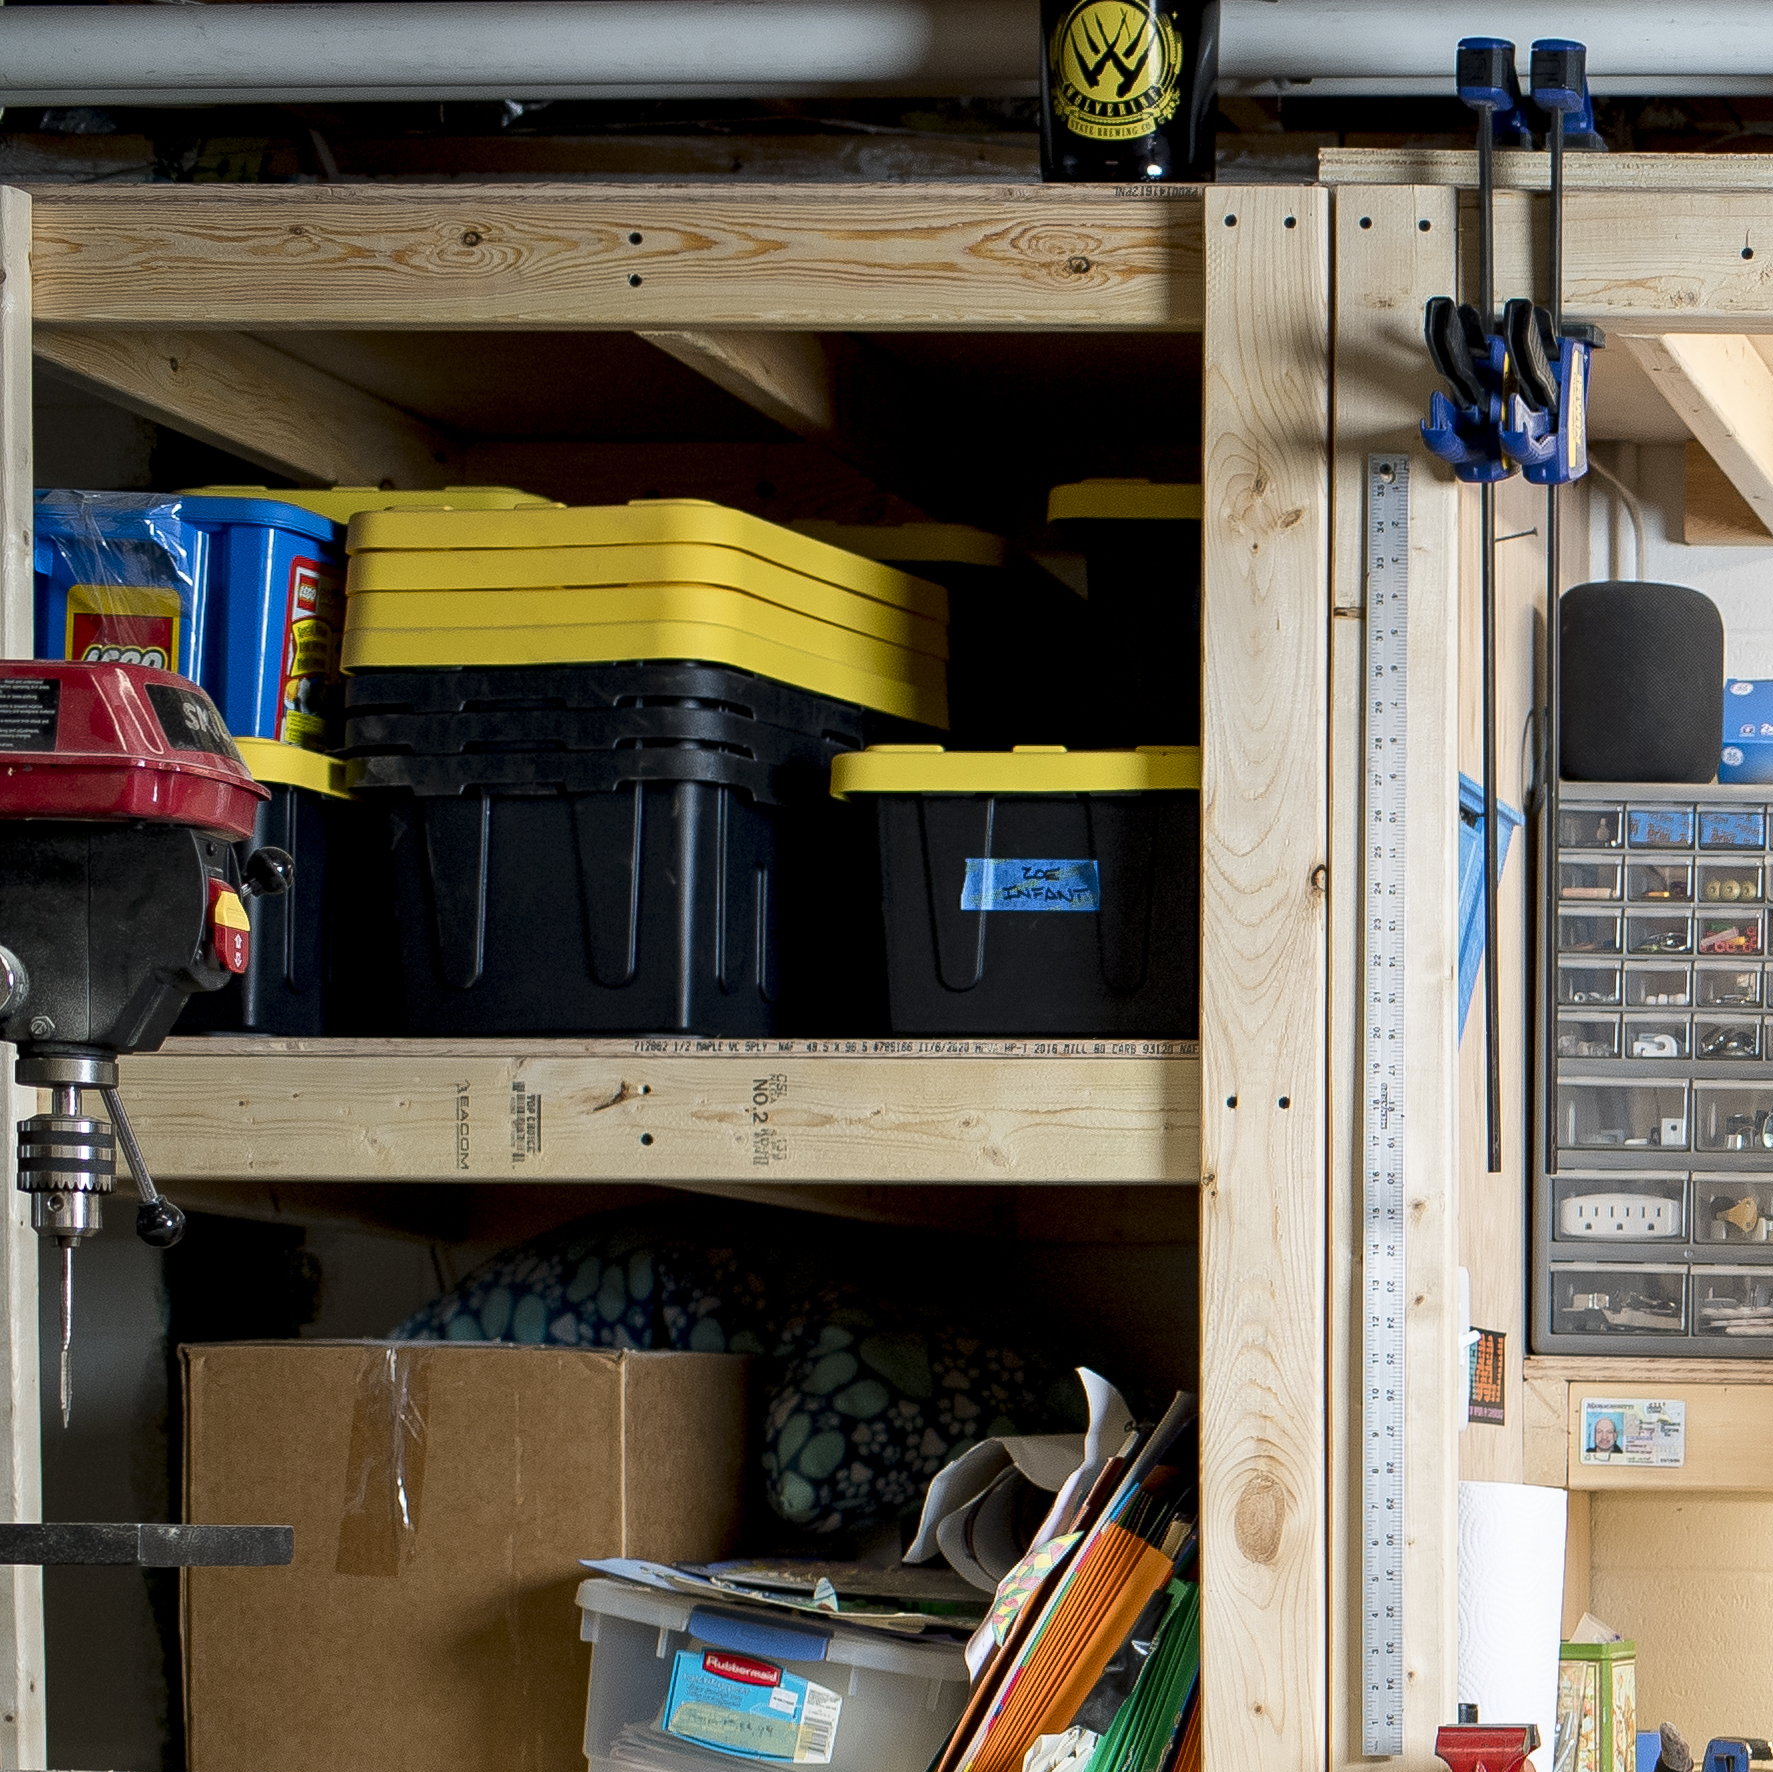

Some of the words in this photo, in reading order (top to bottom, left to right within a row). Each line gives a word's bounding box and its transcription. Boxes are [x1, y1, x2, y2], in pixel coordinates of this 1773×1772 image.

[1063, 84, 1164, 116] WOLVERINE
[1070, 120, 1094, 135] STATE
[1097, 125, 1138, 137] BREWING
[1022, 867, 1060, 881] ZOE
[1003, 887, 1088, 902] INFANT
[753, 1079, 769, 1124] NO.2
[460, 1095, 469, 1170] EACOM
[706, 1655, 777, 1682] Rubbermaid
